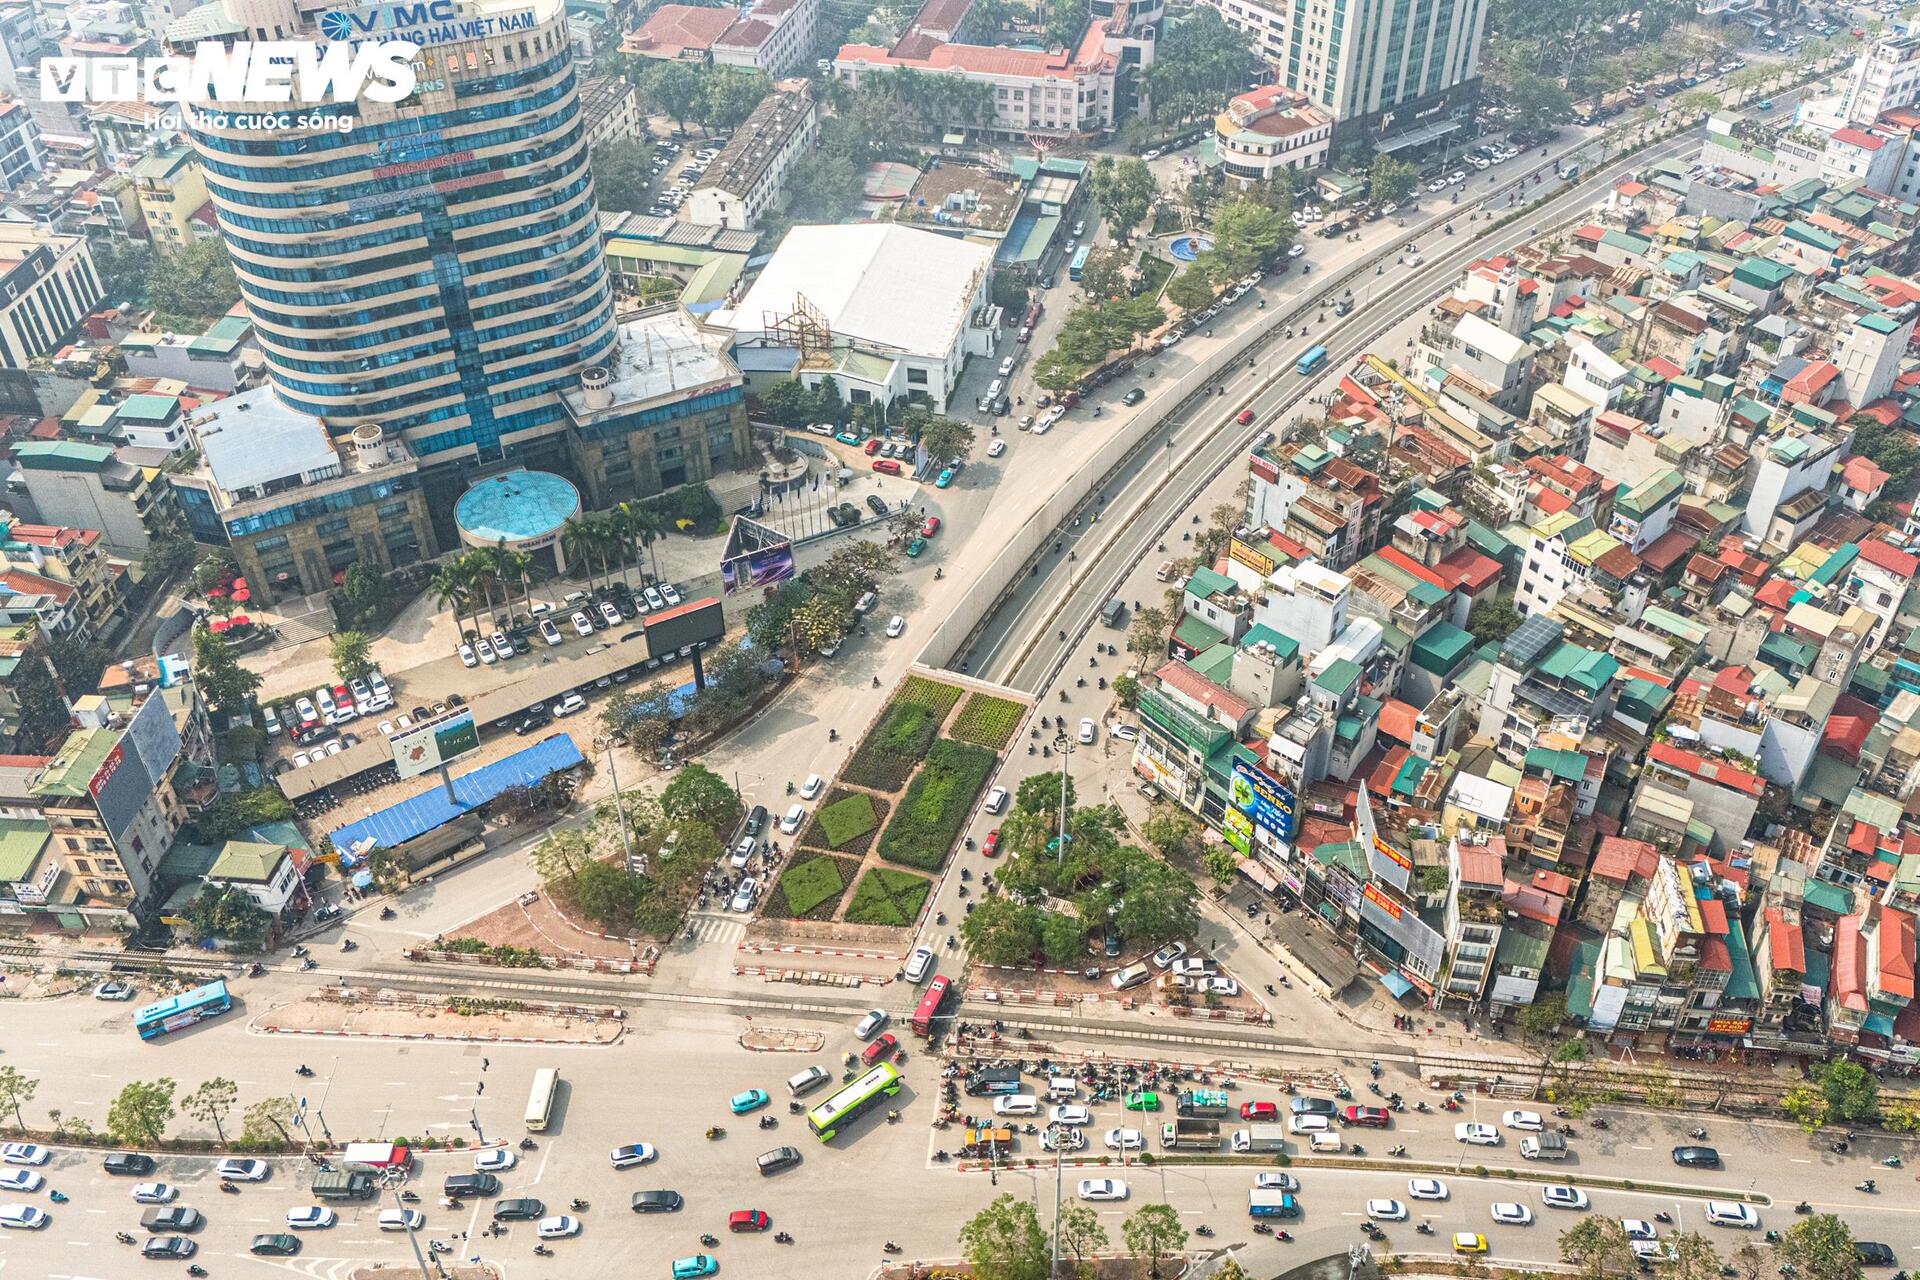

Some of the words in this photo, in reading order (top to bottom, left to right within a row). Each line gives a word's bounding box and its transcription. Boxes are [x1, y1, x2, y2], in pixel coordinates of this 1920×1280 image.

[350, 0, 455, 32] VIMC
[462, 18, 495, 39] VIỆT
[499, 12, 535, 31] NAM
[1253, 783, 1293, 815] SENKO
